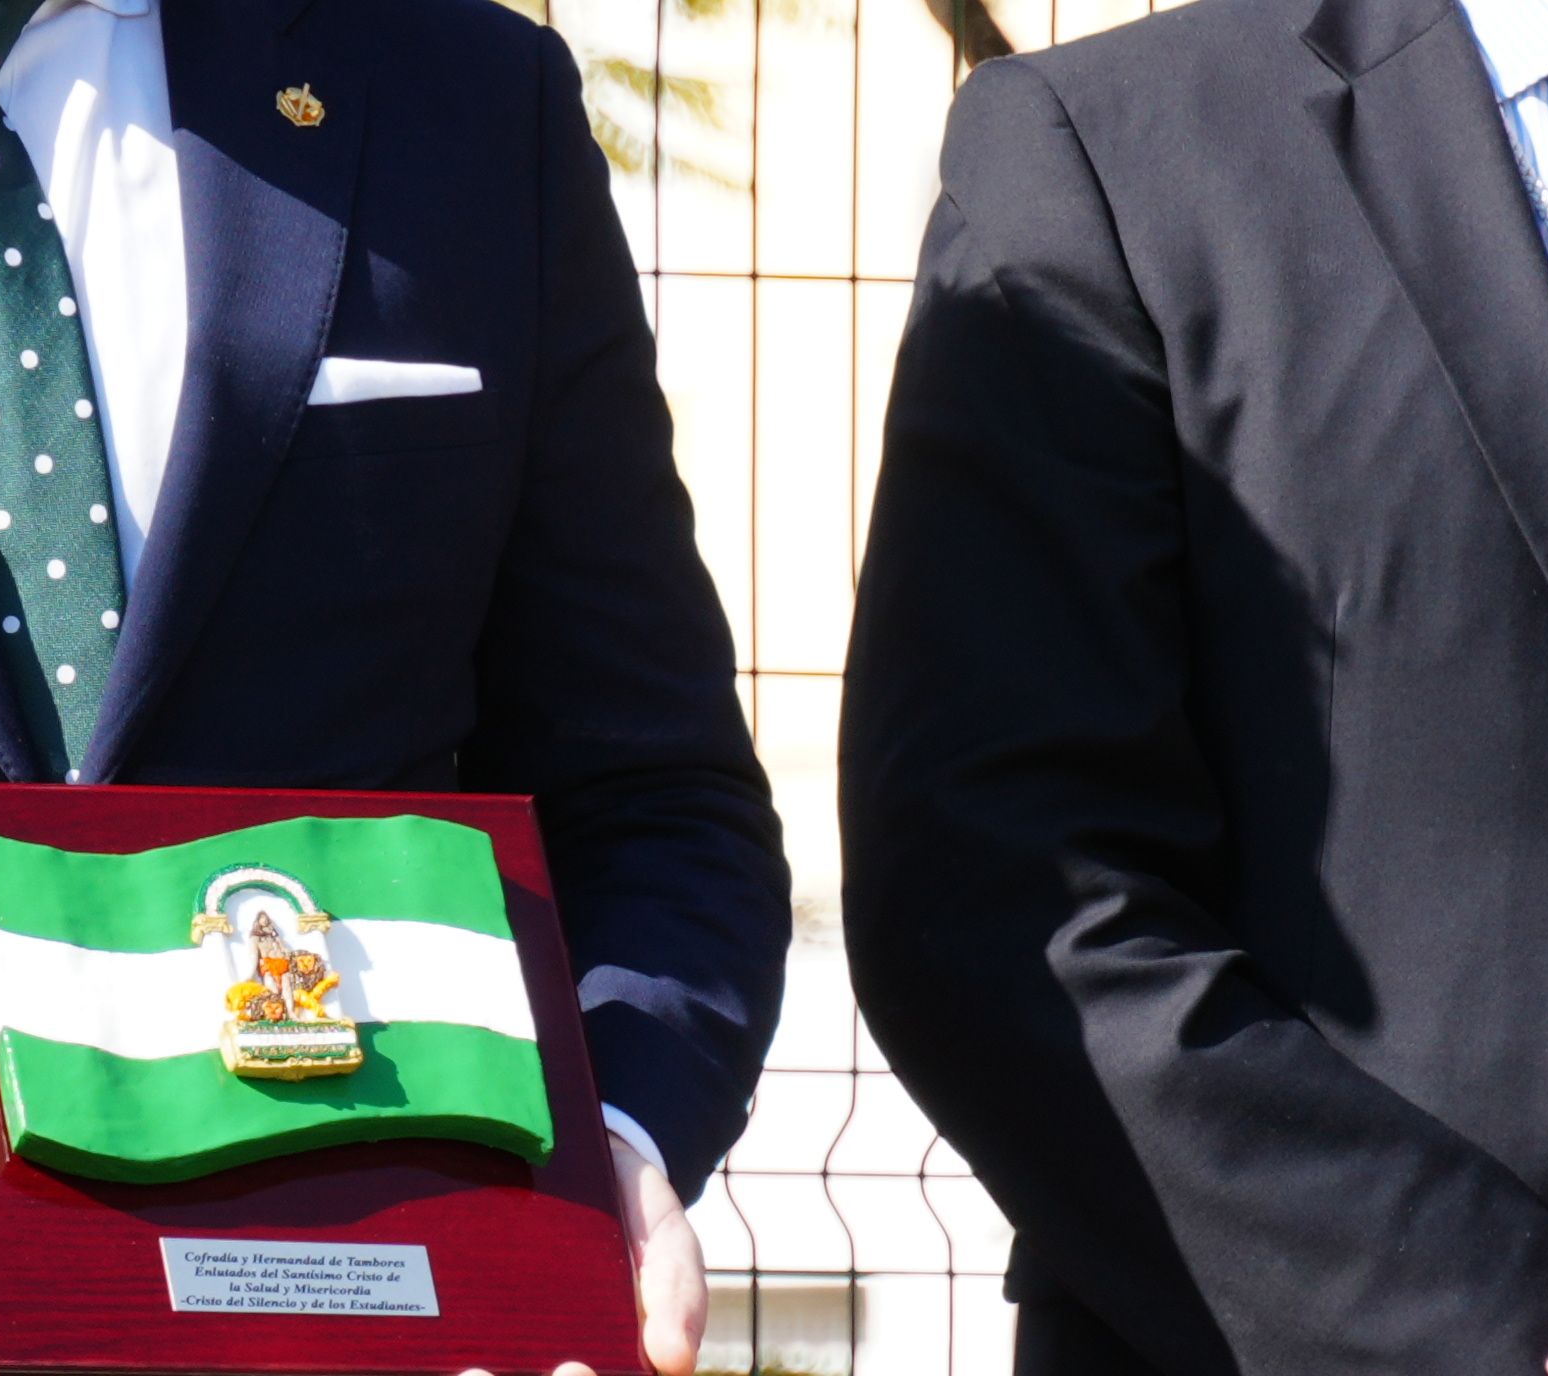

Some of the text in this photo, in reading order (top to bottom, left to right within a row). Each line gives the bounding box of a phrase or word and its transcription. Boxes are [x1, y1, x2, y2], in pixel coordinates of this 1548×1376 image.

[184, 1251, 405, 1268] Cofradía y Hermandad de Tambores
[194, 1266, 400, 1282] Enlutados del Santísimo Cristo de
[229, 1282, 371, 1296] la Salud y Misericordia
[180, 1295, 426, 1312] -Cristo del Silencio y de los Estudiantes-
